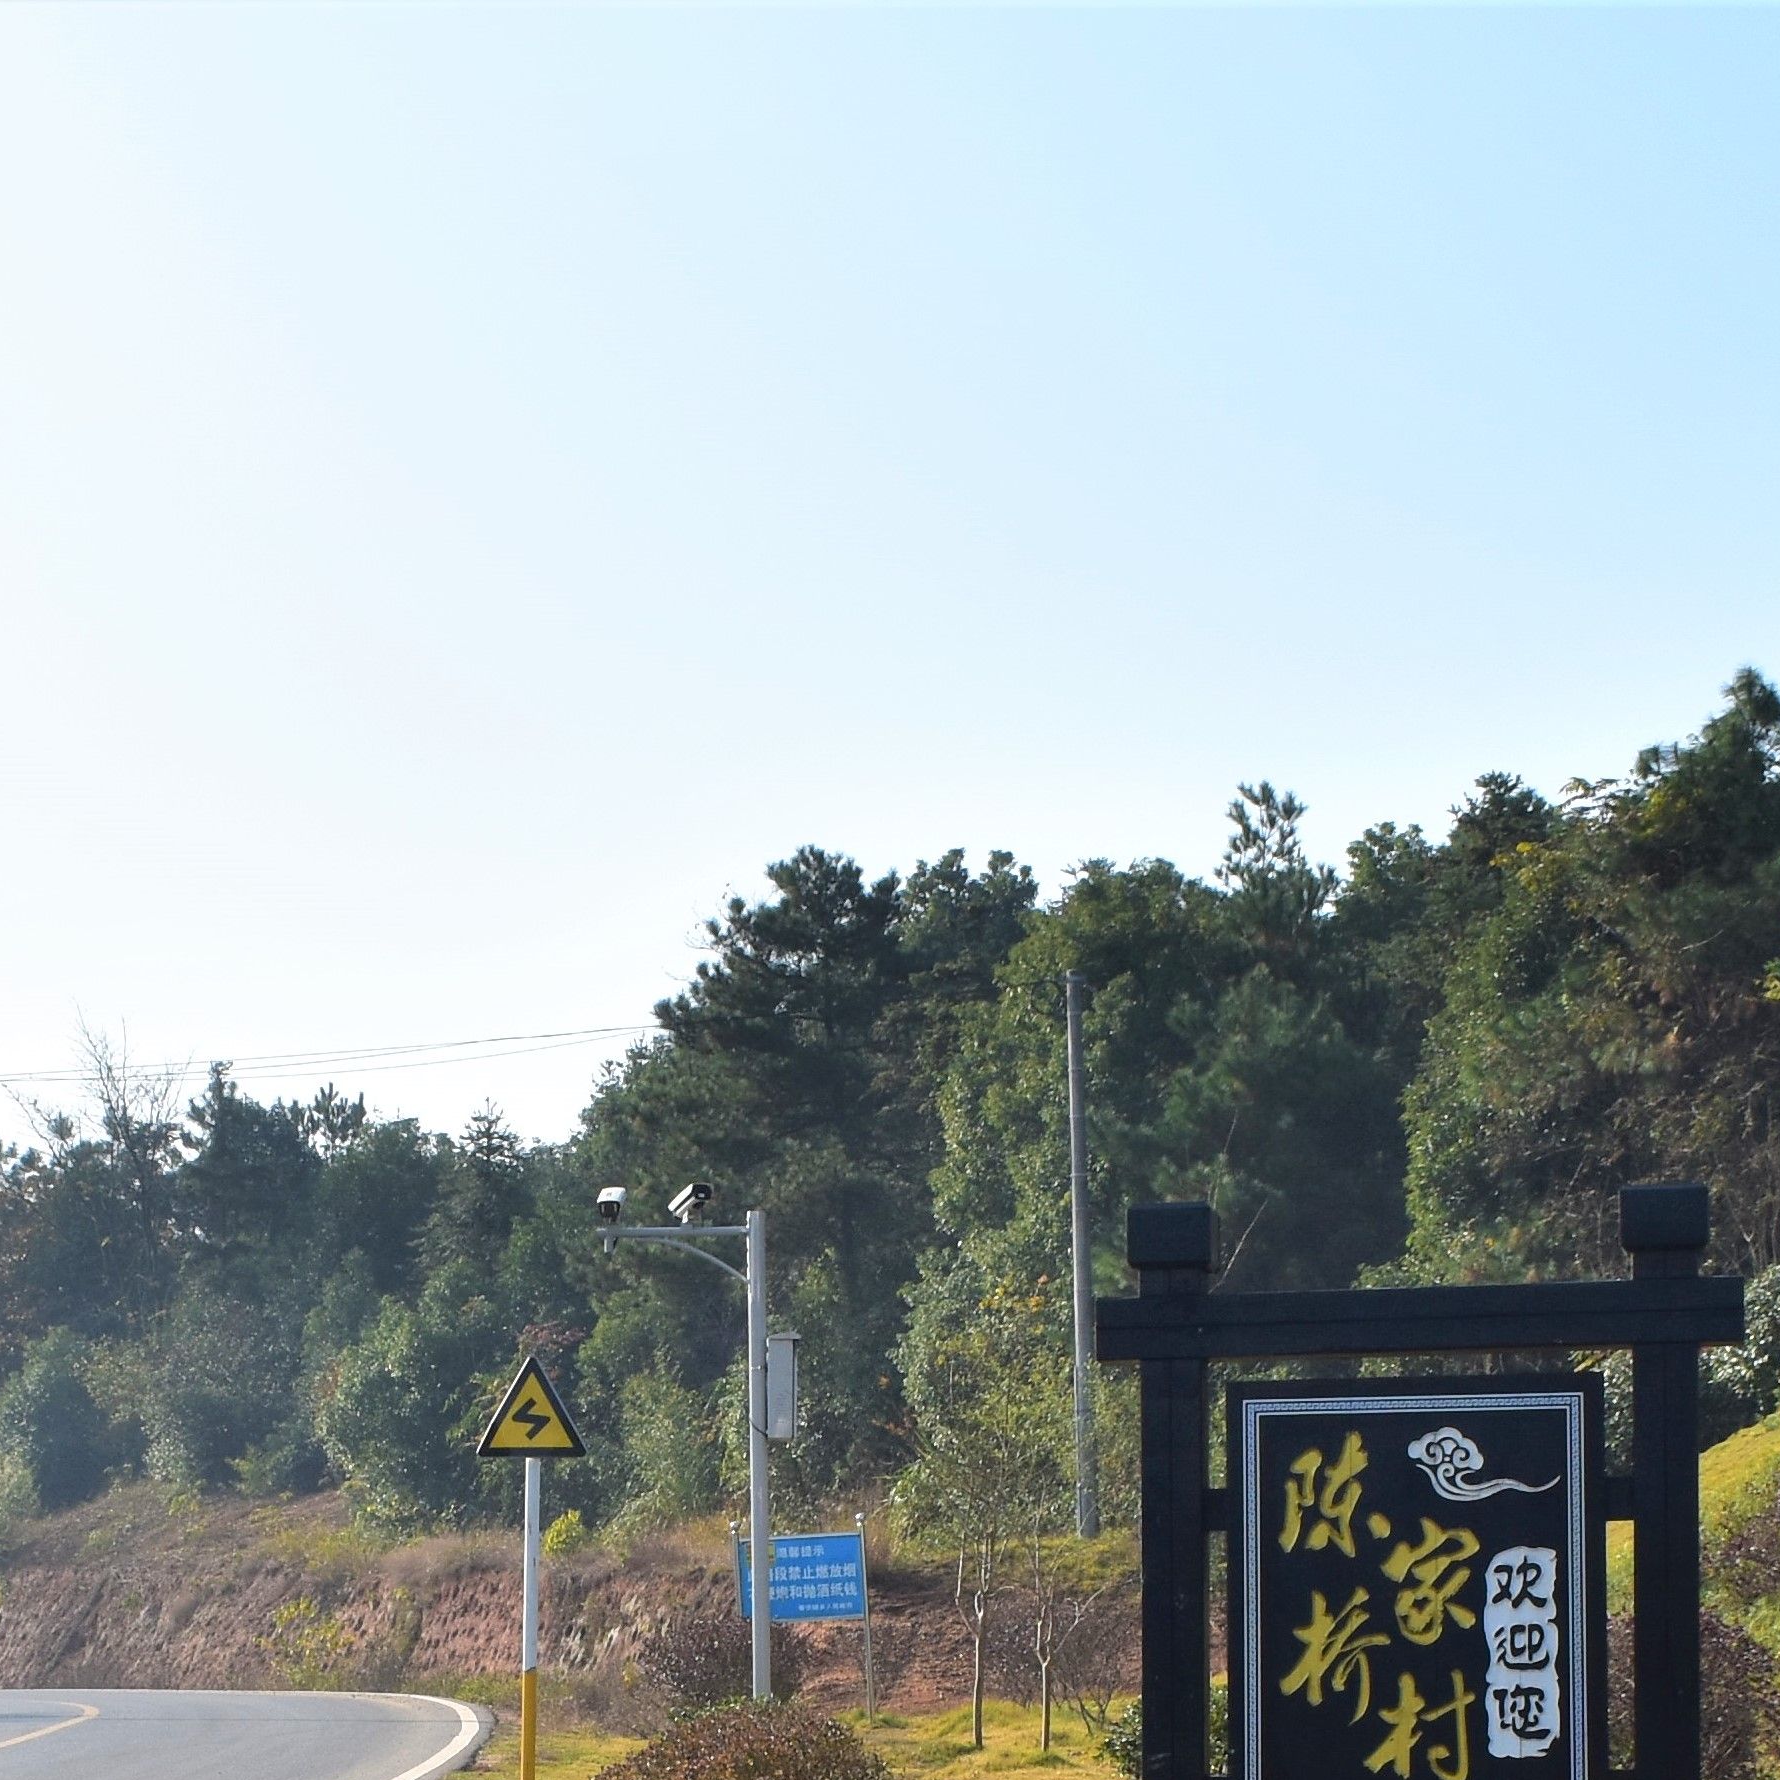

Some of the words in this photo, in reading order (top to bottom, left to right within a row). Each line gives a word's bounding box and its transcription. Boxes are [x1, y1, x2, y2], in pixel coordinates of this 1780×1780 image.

[747, 1563, 857, 1582] 段禁止燃放烟
[1491, 1560, 1551, 1741] 欢迎您
